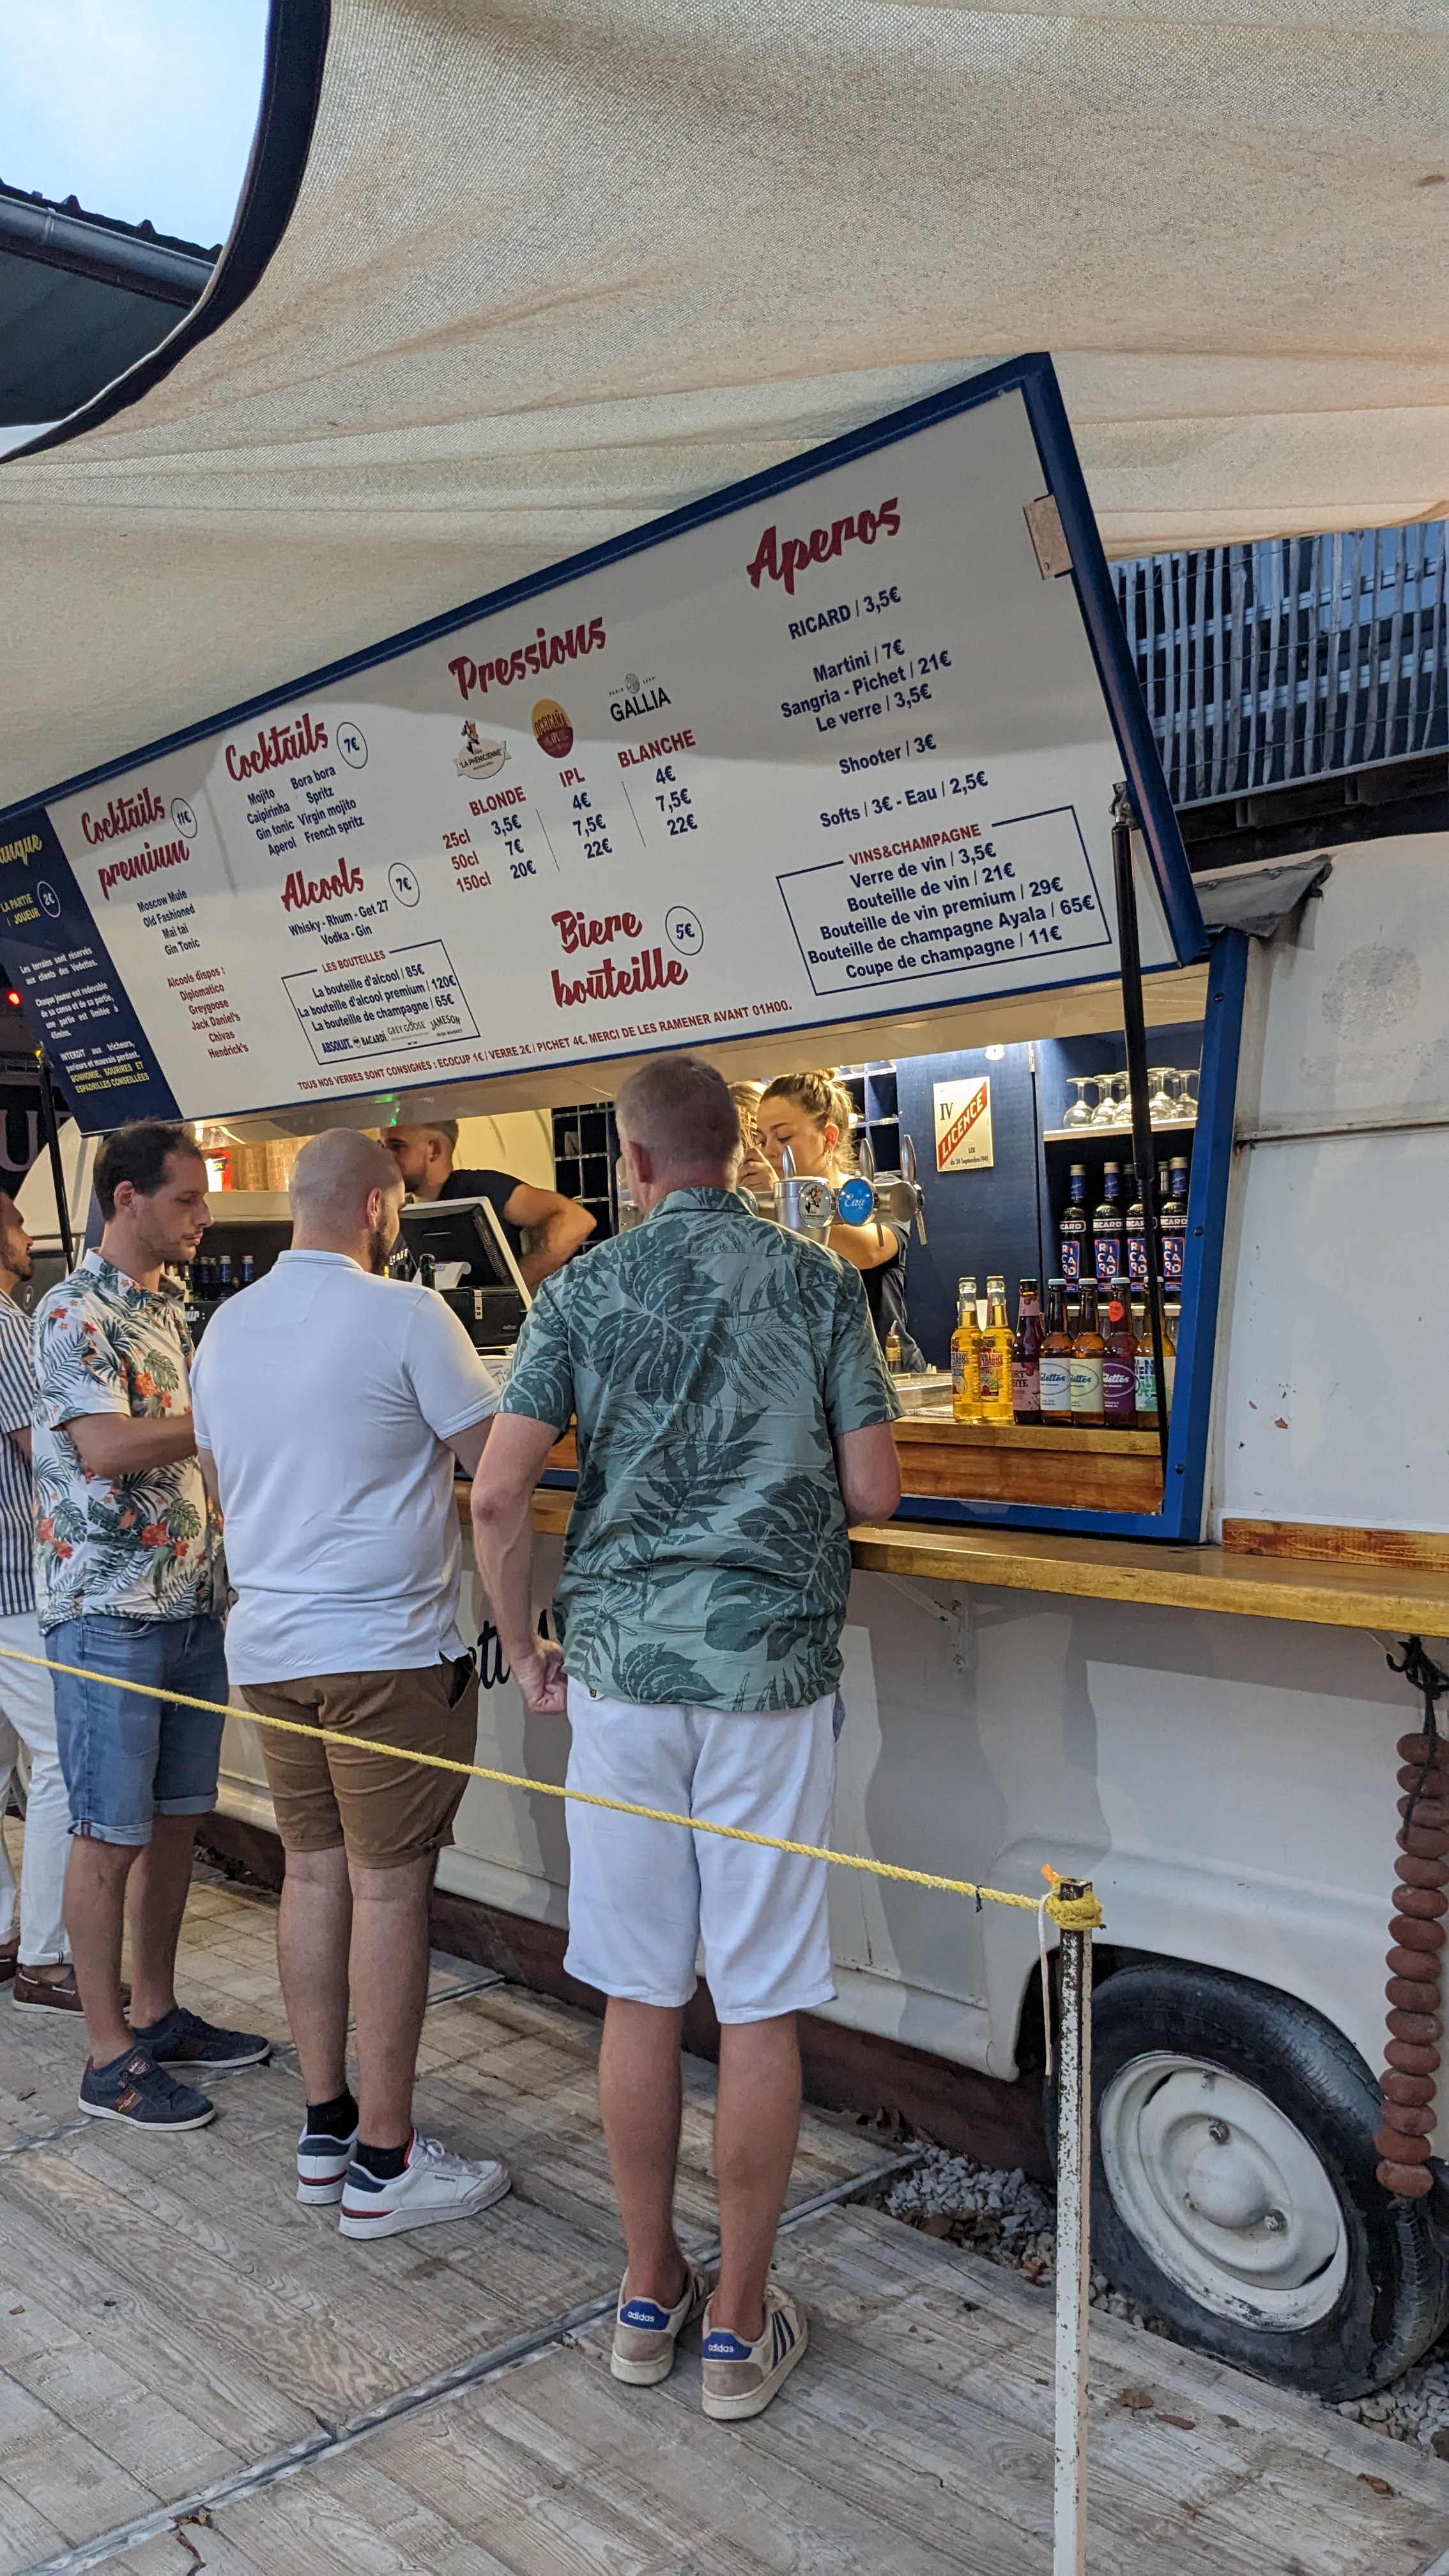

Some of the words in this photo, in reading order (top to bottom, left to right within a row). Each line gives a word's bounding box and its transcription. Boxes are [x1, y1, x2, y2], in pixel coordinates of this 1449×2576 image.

[746, 497, 901, 595] Aperos
[788, 604, 851, 640] RICARD
[863, 586, 901, 613] 3,5€
[448, 617, 606, 701] Pressions
[812, 650, 871, 682] Martini
[881, 639, 905, 660] 7€
[781, 689, 841, 718] Sangria
[852, 666, 907, 696] Pichet
[917, 650, 951, 675] 21€
[610, 687, 671, 722] GALLIA
[815, 717, 837, 732] Le
[839, 703, 882, 724] verre
[894, 683, 932, 709] 3,5€
[225, 712, 328, 781] Cocktails
[344, 737, 360, 754] 7€
[617, 729, 696, 768] BLANCHE
[839, 746, 901, 774] Shooter
[914, 733, 937, 753] 3€
[289, 775, 314, 790] Bora
[312, 766, 336, 782] bora
[559, 767, 586, 788] IPL
[656, 765, 676, 785] 4€
[247, 788, 275, 806] Mojito
[306, 786, 335, 805] Spritz
[468, 786, 526, 816] BLONDE
[572, 792, 592, 810] 4€
[655, 788, 692, 813] 7,5€
[820, 807, 861, 827] Softs
[871, 796, 893, 814] 3€
[904, 788, 938, 806] Eau
[949, 770, 988, 795] 2,5€
[81, 786, 165, 845] Cocktails
[176, 811, 192, 825] 11€
[247, 802, 291, 825] Caipirinha
[296, 809, 326, 826] Virgin
[326, 799, 356, 817] mojito
[666, 813, 698, 836] 22€
[256, 827, 272, 840] Gin
[272, 820, 295, 836] tonic
[303, 824, 337, 843] French
[337, 816, 365, 834] spritz
[491, 814, 522, 837] 3,5€
[572, 813, 606, 838] 7,5€
[268, 836, 297, 856] Aperol
[442, 829, 471, 850] 25cl
[504, 838, 525, 855] 7€
[584, 838, 613, 859] 22€
[848, 824, 981, 866] VINS&CHAMPAGNE
[97, 839, 190, 901] premium
[450, 850, 480, 870] 50cl
[510, 859, 537, 880] 20€
[849, 870, 894, 888] Verre
[898, 862, 918, 878] de
[921, 856, 947, 873] vin
[958, 842, 997, 866] 3,5€
[280, 857, 364, 912] Alcools
[395, 877, 412, 892] 7€
[456, 871, 491, 893] 150cl
[847, 886, 916, 912] Bouteille
[920, 881, 940, 896] de
[944, 875, 970, 891] vin
[981, 862, 1016, 884] 21€
[136, 896, 168, 913] Moscow
[167, 889, 188, 903] Mule
[820, 916, 887, 940] Bouteille
[891, 910, 910, 926] de
[913, 905, 939, 921] vin
[942, 890, 1016, 919] premium
[1029, 877, 1064, 898] 29€
[143, 915, 158, 928] Old
[156, 903, 196, 924] Fashioned
[288, 920, 321, 937] Whisky
[325, 912, 353, 926] Rhum
[358, 904, 378, 917] Get
[376, 900, 388, 913] 27
[319, 931, 351, 946] Vodka
[355, 924, 372, 937] Gin
[551, 910, 643, 954] Biere
[676, 923, 695, 940] 5€
[807, 940, 873, 964] Bouteille
[877, 936, 896, 951] de
[900, 919, 993, 946] champagne
[999, 907, 1046, 929] Ayala
[1060, 894, 1095, 915] 65€
[164, 944, 179, 955] Gin
[177, 938, 201, 951] Tonic
[846, 961, 893, 978] Coupe
[897, 954, 917, 969] de
[921, 938, 1015, 965] champagne
[1029, 925, 1062, 945] 11€
[321, 962, 337, 973] LES
[337, 950, 386, 969] BOUTEILLES
[167, 973, 195, 988] Alcools
[195, 968, 221, 981] dispos
[311, 988, 325, 999] La
[323, 978, 364, 995] bouteille
[364, 969, 401, 987] d'alcool
[405, 963, 425, 977] 85€
[551, 947, 689, 1008] bouteille
[179, 984, 225, 1002] Diplomatico
[297, 1008, 310, 1018] La
[309, 999, 348, 1015] bouteille
[348, 990, 384, 1008] d'alcool
[384, 984, 426, 1003] premium
[431, 974, 457, 990] 120€
[188, 999, 229, 1015] Greygoose
[311, 1021, 325, 1032] La
[323, 1013, 362, 1029] bouteille
[363, 1010, 375, 1022] de
[376, 1001, 429, 1019] champagne
[434, 993, 455, 1008] 65€
[192, 1018, 211, 1031] Jack
[208, 1011, 241, 1027] Daniel's
[208, 1031, 235, 1043] Chivas
[296, 1080, 318, 1091] TOUS
[317, 1077, 334, 1087] NOS
[333, 1072, 364, 1085] VERRES
[364, 1068, 385, 1080] SONT
[386, 1061, 433, 1077] CONSIGNÉS
[436, 1054, 471, 1068] ECOCUP
[473, 1052, 484, 1062] 1€
[487, 1046, 519, 1059] VERRE
[519, 1044, 532, 1055] 2€
[536, 1038, 570, 1052] PICHET
[573, 1035, 588, 1046] 4€.
[588, 1029, 620, 1043] MERCI
[621, 1026, 636, 1038] DE
[636, 1023, 657, 1036] LES
[658, 1013, 712, 1032] RAMENER
[714, 1006, 749, 1023] AVANT
[752, 1000, 792, 1016] 01H00.
[207, 1042, 249, 1059] Hendrick's
[940, 1102, 954, 1121] IV
[942, 1091, 983, 1160] LICENCE
[961, 1156, 981, 1165] Septembre
[844, 1193, 866, 1209] Eau
[627, 2311, 656, 2323] adidas
[709, 2343, 735, 2353] adidas
